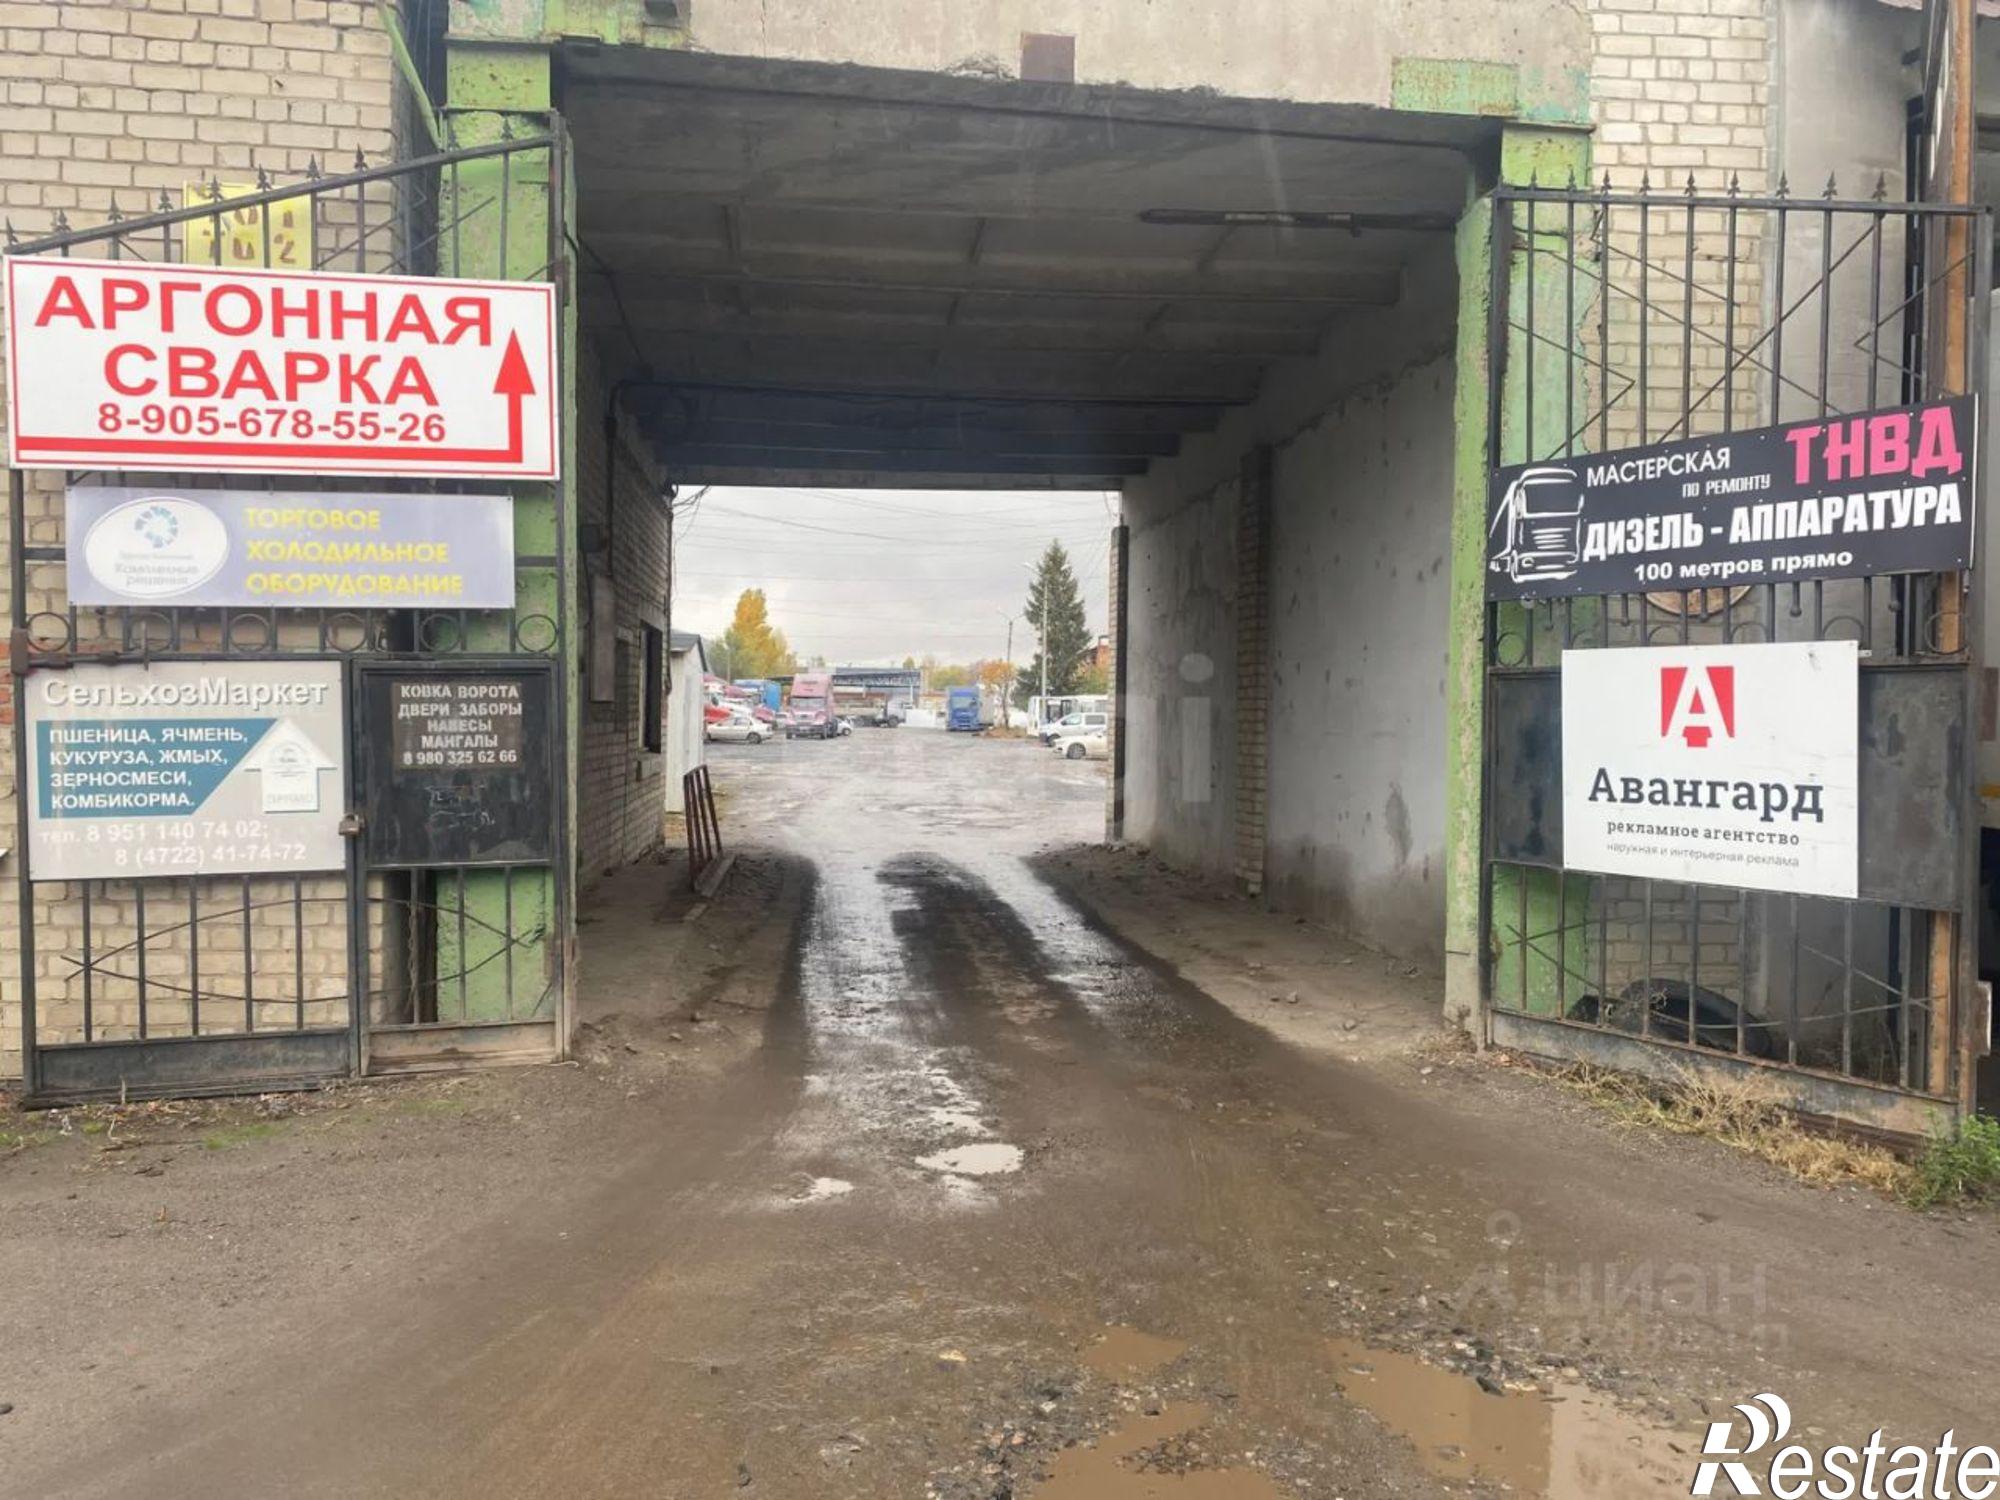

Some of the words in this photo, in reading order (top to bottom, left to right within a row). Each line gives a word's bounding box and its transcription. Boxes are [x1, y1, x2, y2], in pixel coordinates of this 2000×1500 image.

[35, 275, 491, 347] АРГОННАЯ
[103, 343, 440, 406] СВАРКА
[98, 402, 446, 442] 8-905-678-55-26
[1587, 447, 1731, 488] МАСТЕРСКАЯ
[1785, 405, 1963, 486] ТНВД
[1682, 482, 1700, 499] ПО
[1706, 473, 1771, 497] РЕМОНТУ
[244, 507, 381, 531] ТОРГОВОЕ
[1583, 511, 1704, 562] ДИЗЕЛЬ
[1729, 482, 1962, 545] АППАРАТУРА
[246, 539, 450, 565] ХОЛОДИЛЬНОЕ
[1634, 561, 1674, 583] 100
[1679, 556, 1764, 584] метров
[1771, 550, 1853, 576] прямо
[246, 572, 464, 598] ОБОРУДОВАНИЕ
[44, 676, 329, 711] СельхозМаркет
[400, 684, 452, 699] КОВКА
[458, 684, 519, 699] ВОРОТА
[398, 702, 450, 719] ДВЕРИ
[459, 702, 523, 716] ЗАБОРЫ
[50, 727, 156, 746] ПШЕНИЦА,
[161, 726, 248, 744] ЯЧМЕНЬ,
[427, 719, 492, 733] НАВЕСЫ
[421, 734, 499, 749] МАНГАЛЫ
[50, 749, 154, 766] КУКУРУЗА,
[159, 748, 228, 766] ЖМЫХ,
[403, 751, 413, 765] 8
[416, 751, 444, 765] 980
[447, 750, 474, 765] 325
[478, 750, 496, 763] 62
[499, 749, 517, 763] 66
[51, 771, 193, 788] ЗЕРНОСМЕСИ,
[51, 792, 195, 810] КОМБИКОРМА.
[1588, 766, 1824, 823] Авангард
[41, 829, 80, 844] тел.
[86, 824, 100, 842] 8
[107, 822, 146, 842] 951
[159, 822, 194, 840] 140
[203, 821, 228, 838] 74
[235, 819, 269, 839] 02;
[1607, 820, 1700, 839] рекламное
[1703, 826, 1800, 846] агентство
[115, 848, 127, 866] 8
[135, 846, 205, 869] (4722)
[211, 843, 307, 863] 41-74-72
[1607, 842, 1658, 856] наружная
[1660, 846, 1668, 855] и
[1670, 846, 1744, 862] интерьерная
[1746, 853, 1800, 868] реклама
